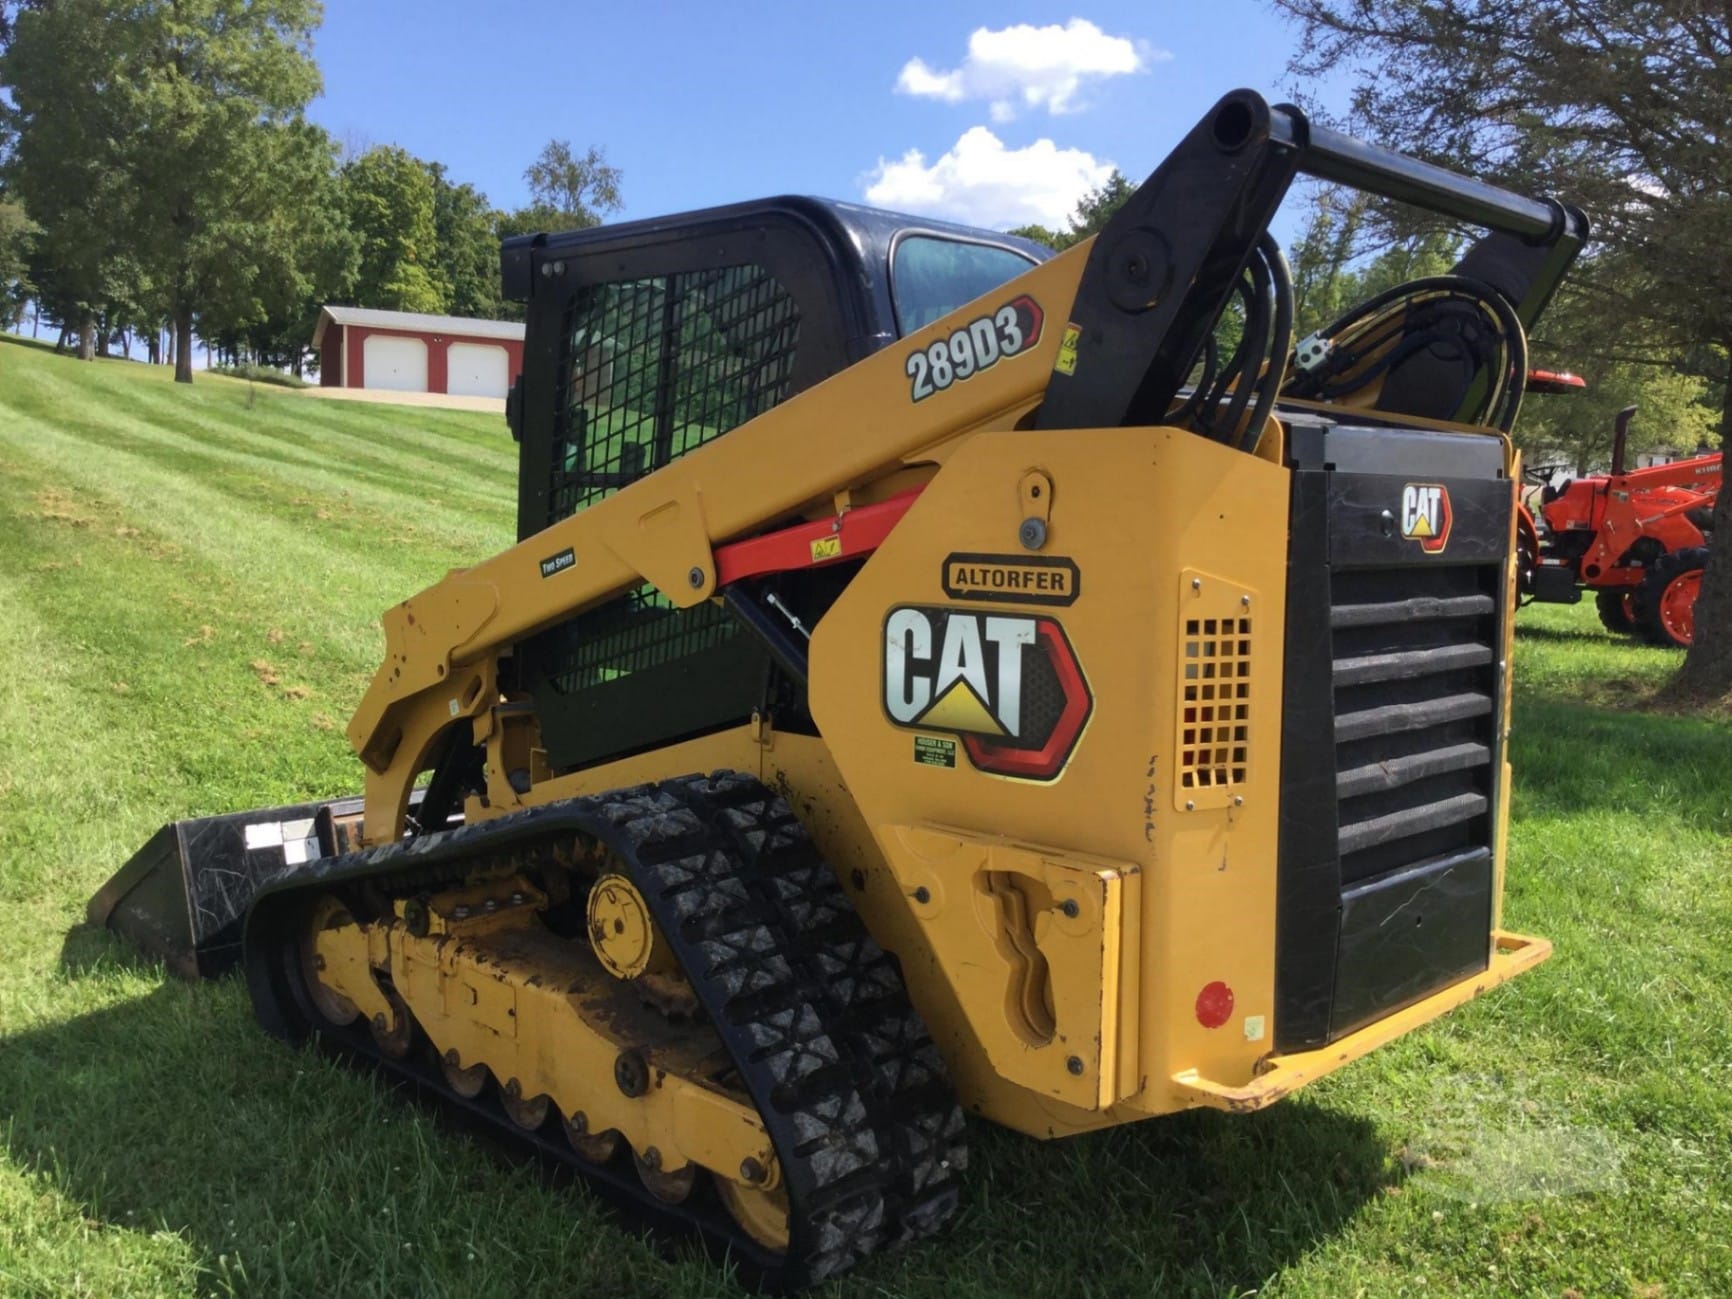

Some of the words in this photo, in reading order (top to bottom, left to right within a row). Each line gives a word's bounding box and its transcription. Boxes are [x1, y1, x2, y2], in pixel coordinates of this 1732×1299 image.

[907, 305, 1023, 401] 289D3
[1402, 486, 1441, 536] CAT
[956, 567, 1065, 591] ALTORFER
[886, 608, 1036, 737] CAT
